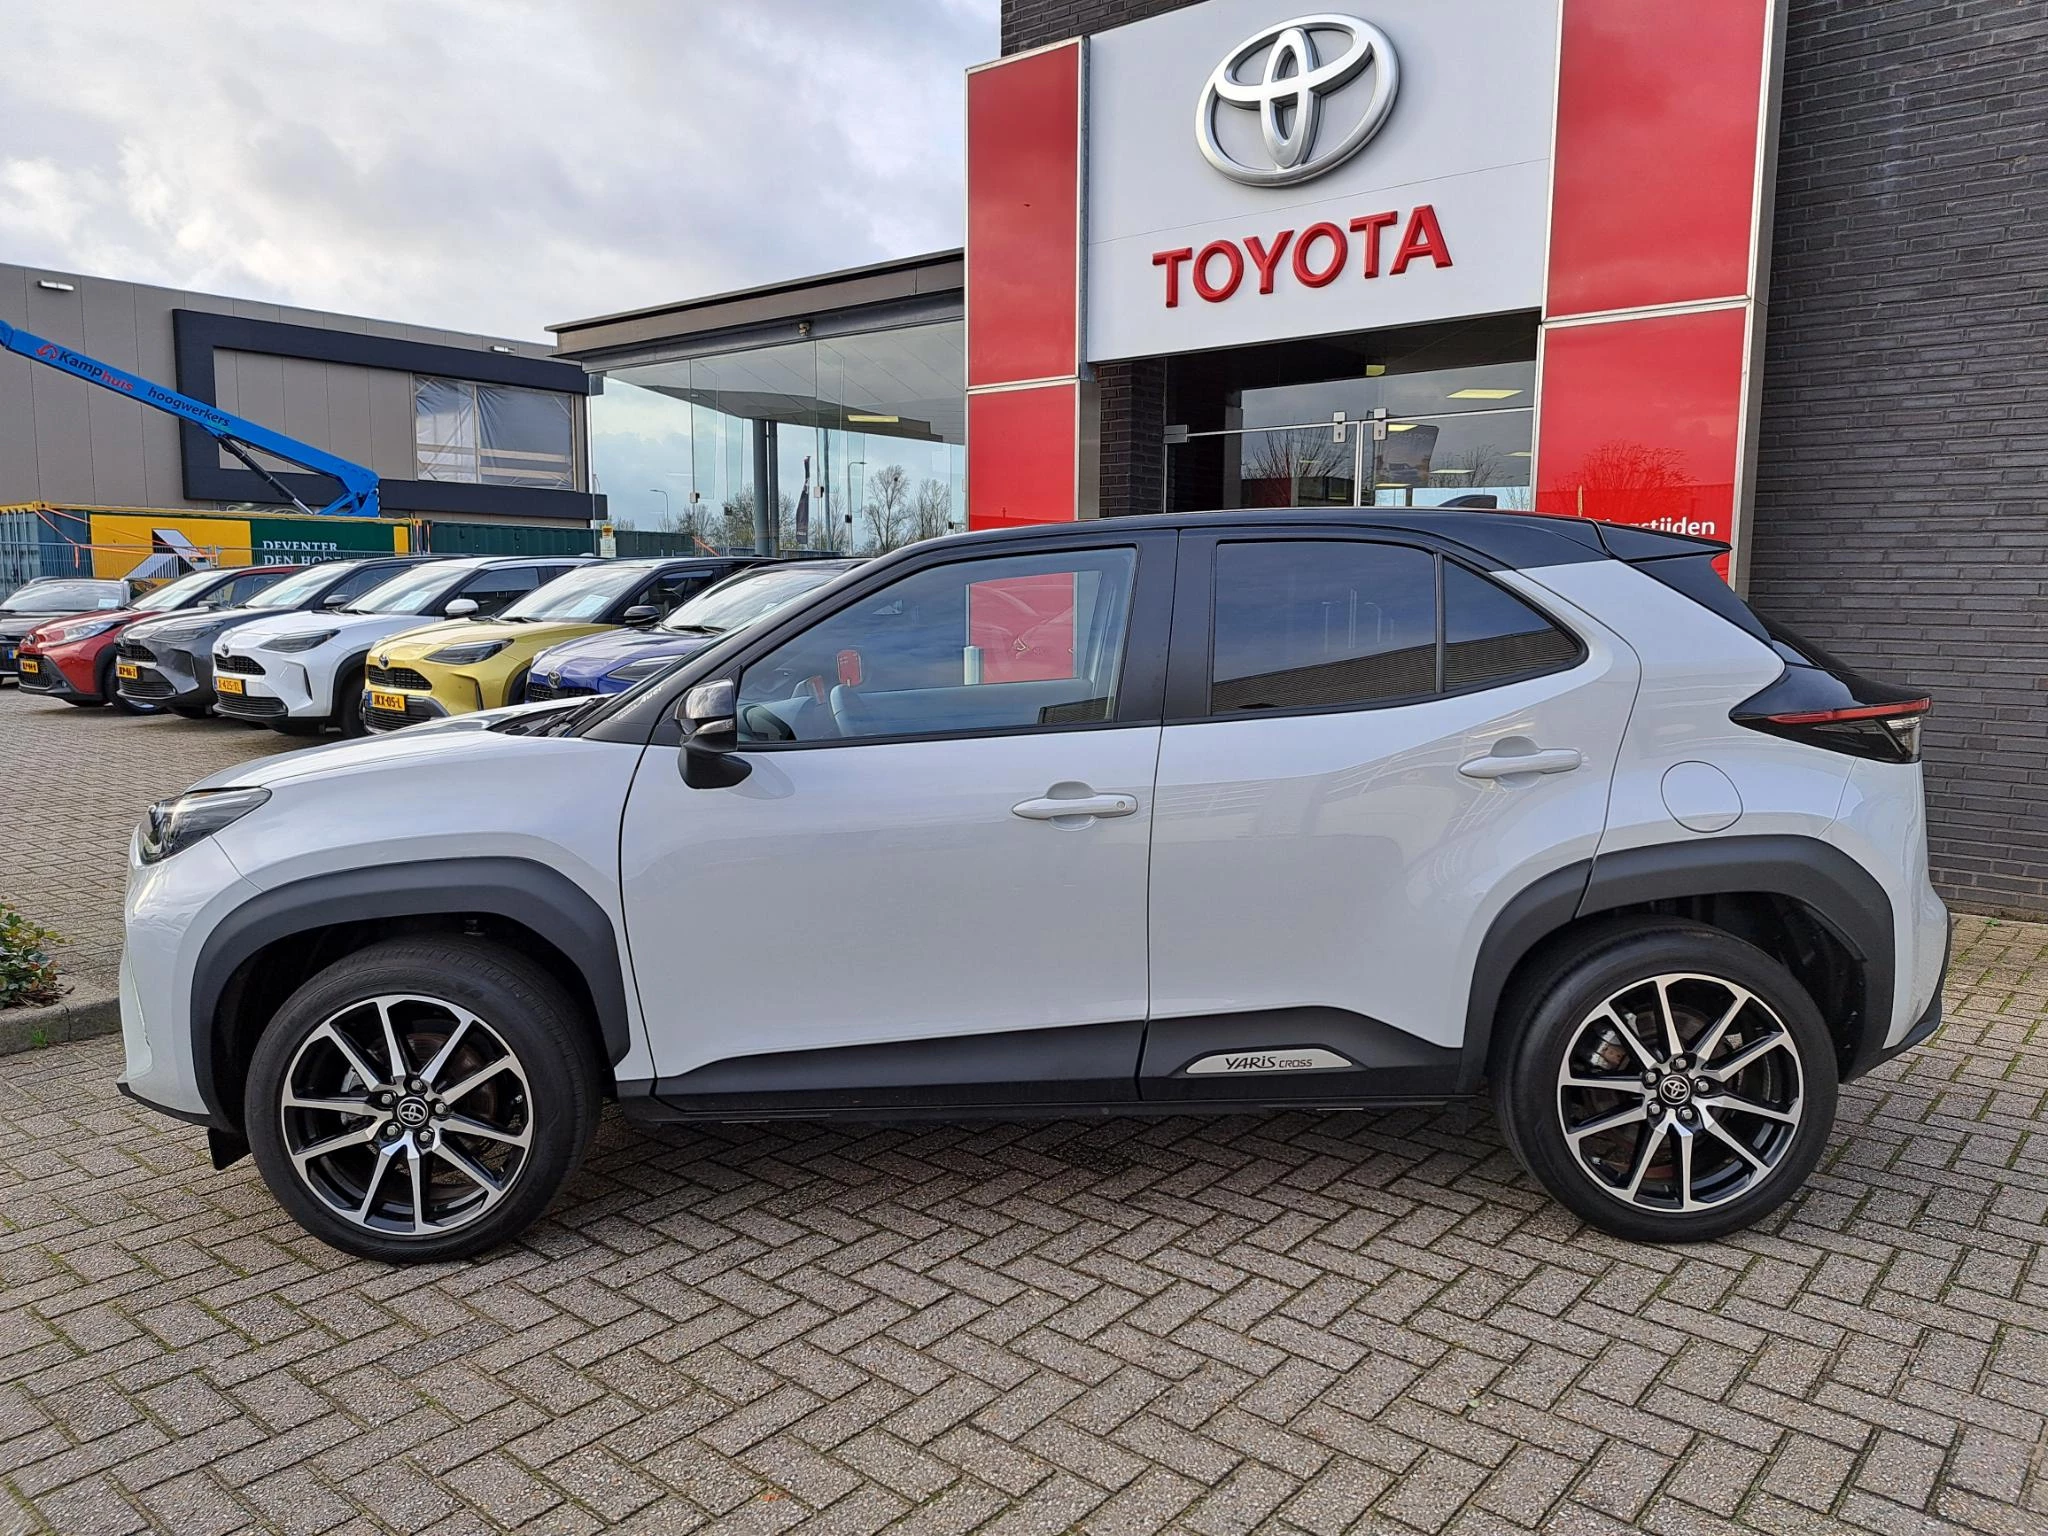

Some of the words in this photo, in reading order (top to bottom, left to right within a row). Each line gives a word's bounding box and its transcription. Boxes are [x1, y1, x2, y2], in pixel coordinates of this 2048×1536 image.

[1152, 204, 1453, 308] TOYOTA
[59, 350, 134, 391] Kamphuis
[147, 386, 231, 426] hoogwerkers
[262, 540, 337, 551] DEVENTER
[263, 554, 294, 566] DEN
[1279, 1059, 1313, 1068] CROSS
